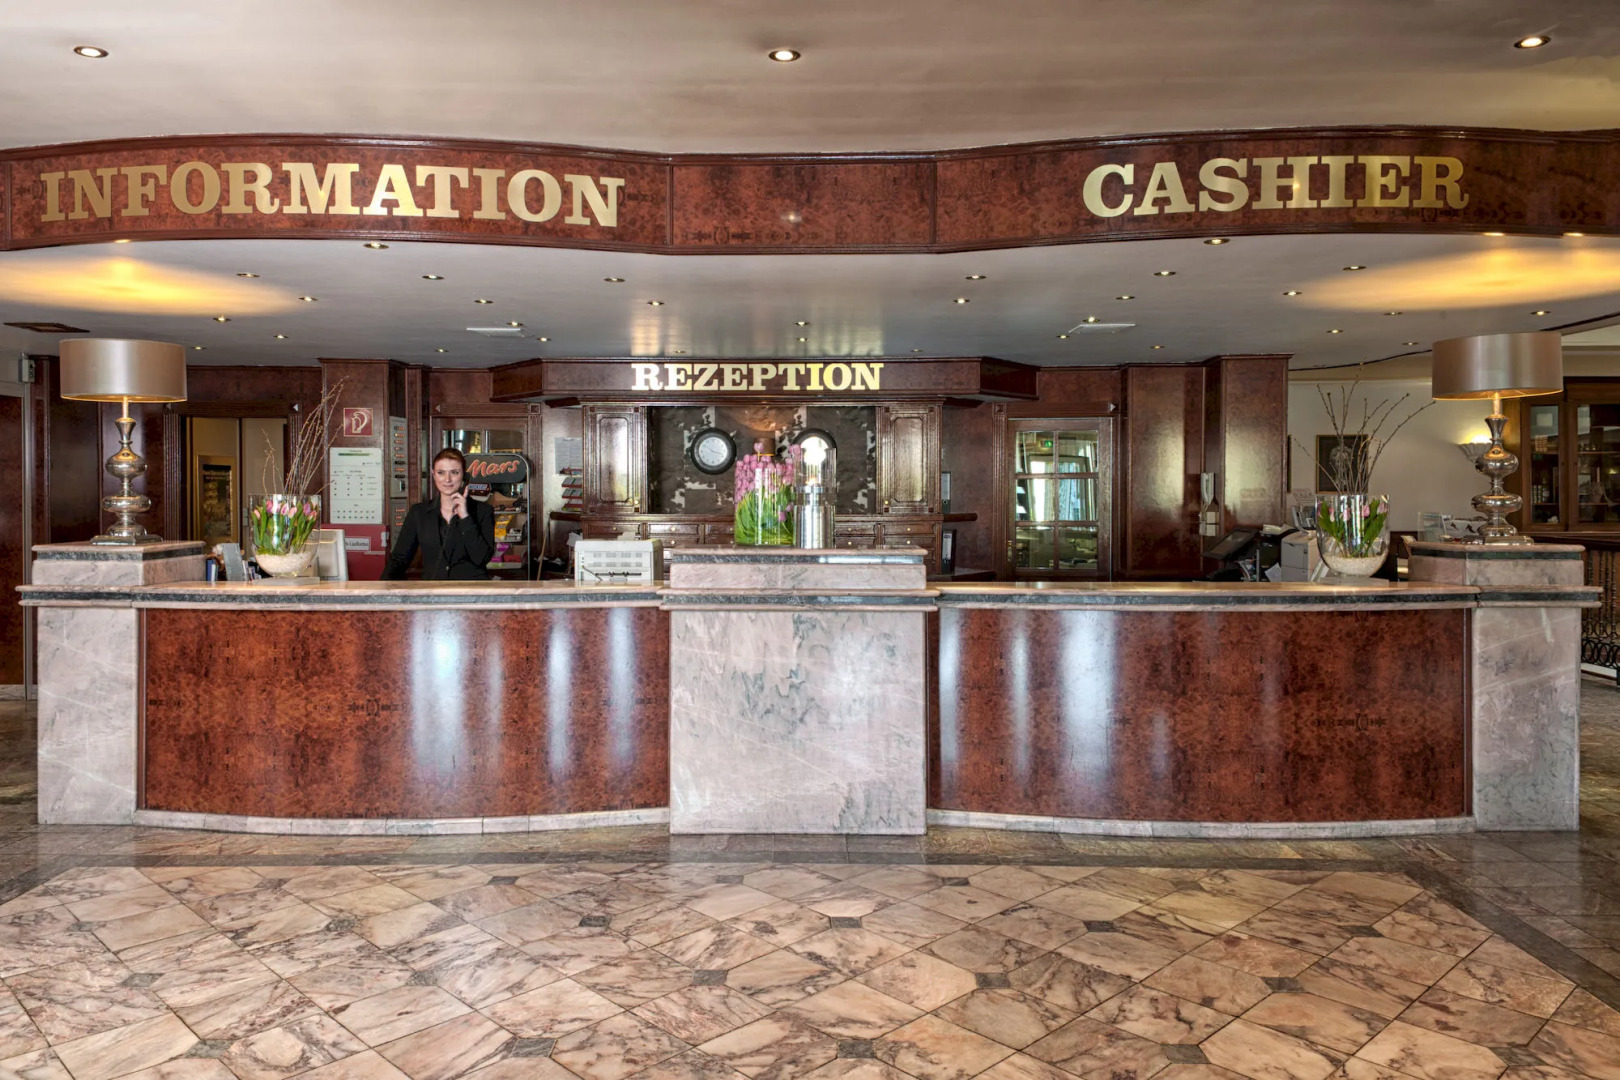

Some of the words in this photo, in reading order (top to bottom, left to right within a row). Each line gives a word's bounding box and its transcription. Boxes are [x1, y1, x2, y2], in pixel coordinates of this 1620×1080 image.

[40, 162, 624, 227] INFORMATION
[1083, 155, 1469, 217] CASHIER
[631, 363, 884, 391] REZEPTION
[467, 460, 519, 477] Mars
